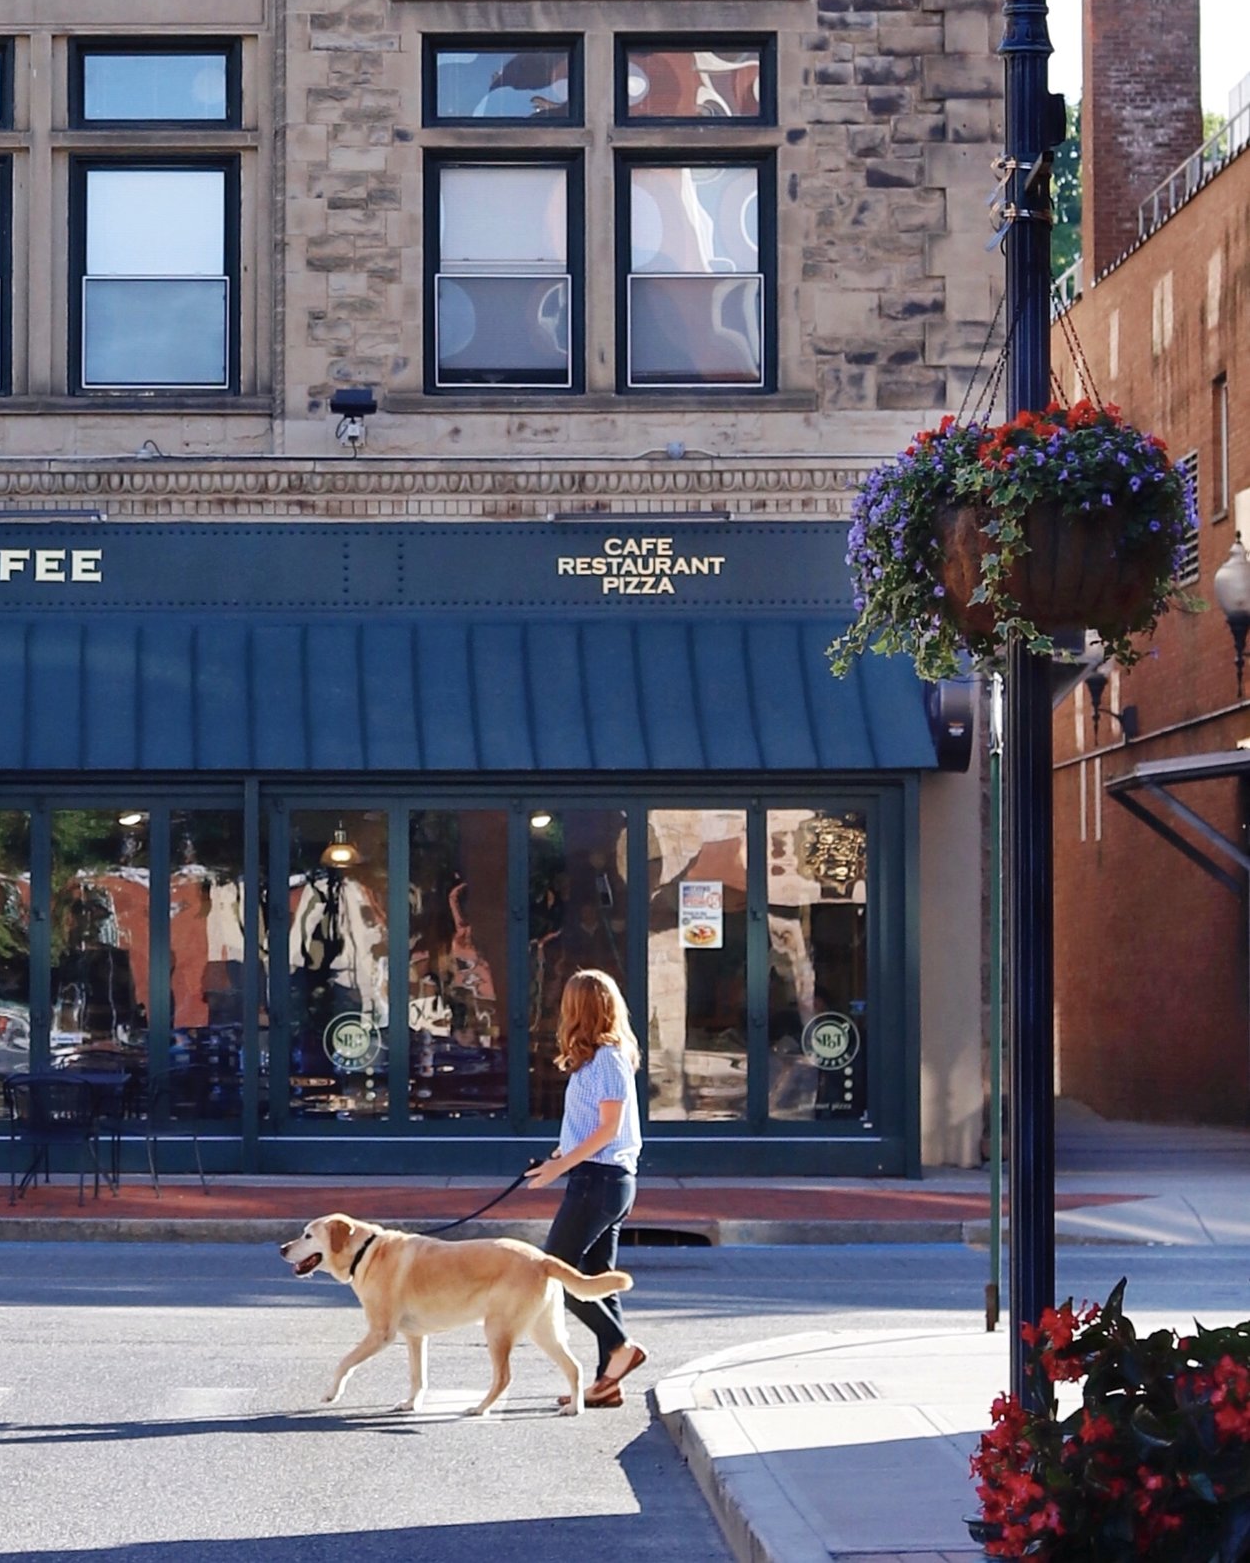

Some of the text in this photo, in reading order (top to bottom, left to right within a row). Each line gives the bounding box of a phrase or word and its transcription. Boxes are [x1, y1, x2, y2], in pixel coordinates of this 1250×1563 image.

[604, 538, 674, 556] CAFE
[557, 557, 726, 575] RESTAURANT
[602, 577, 675, 595] PIZZA
